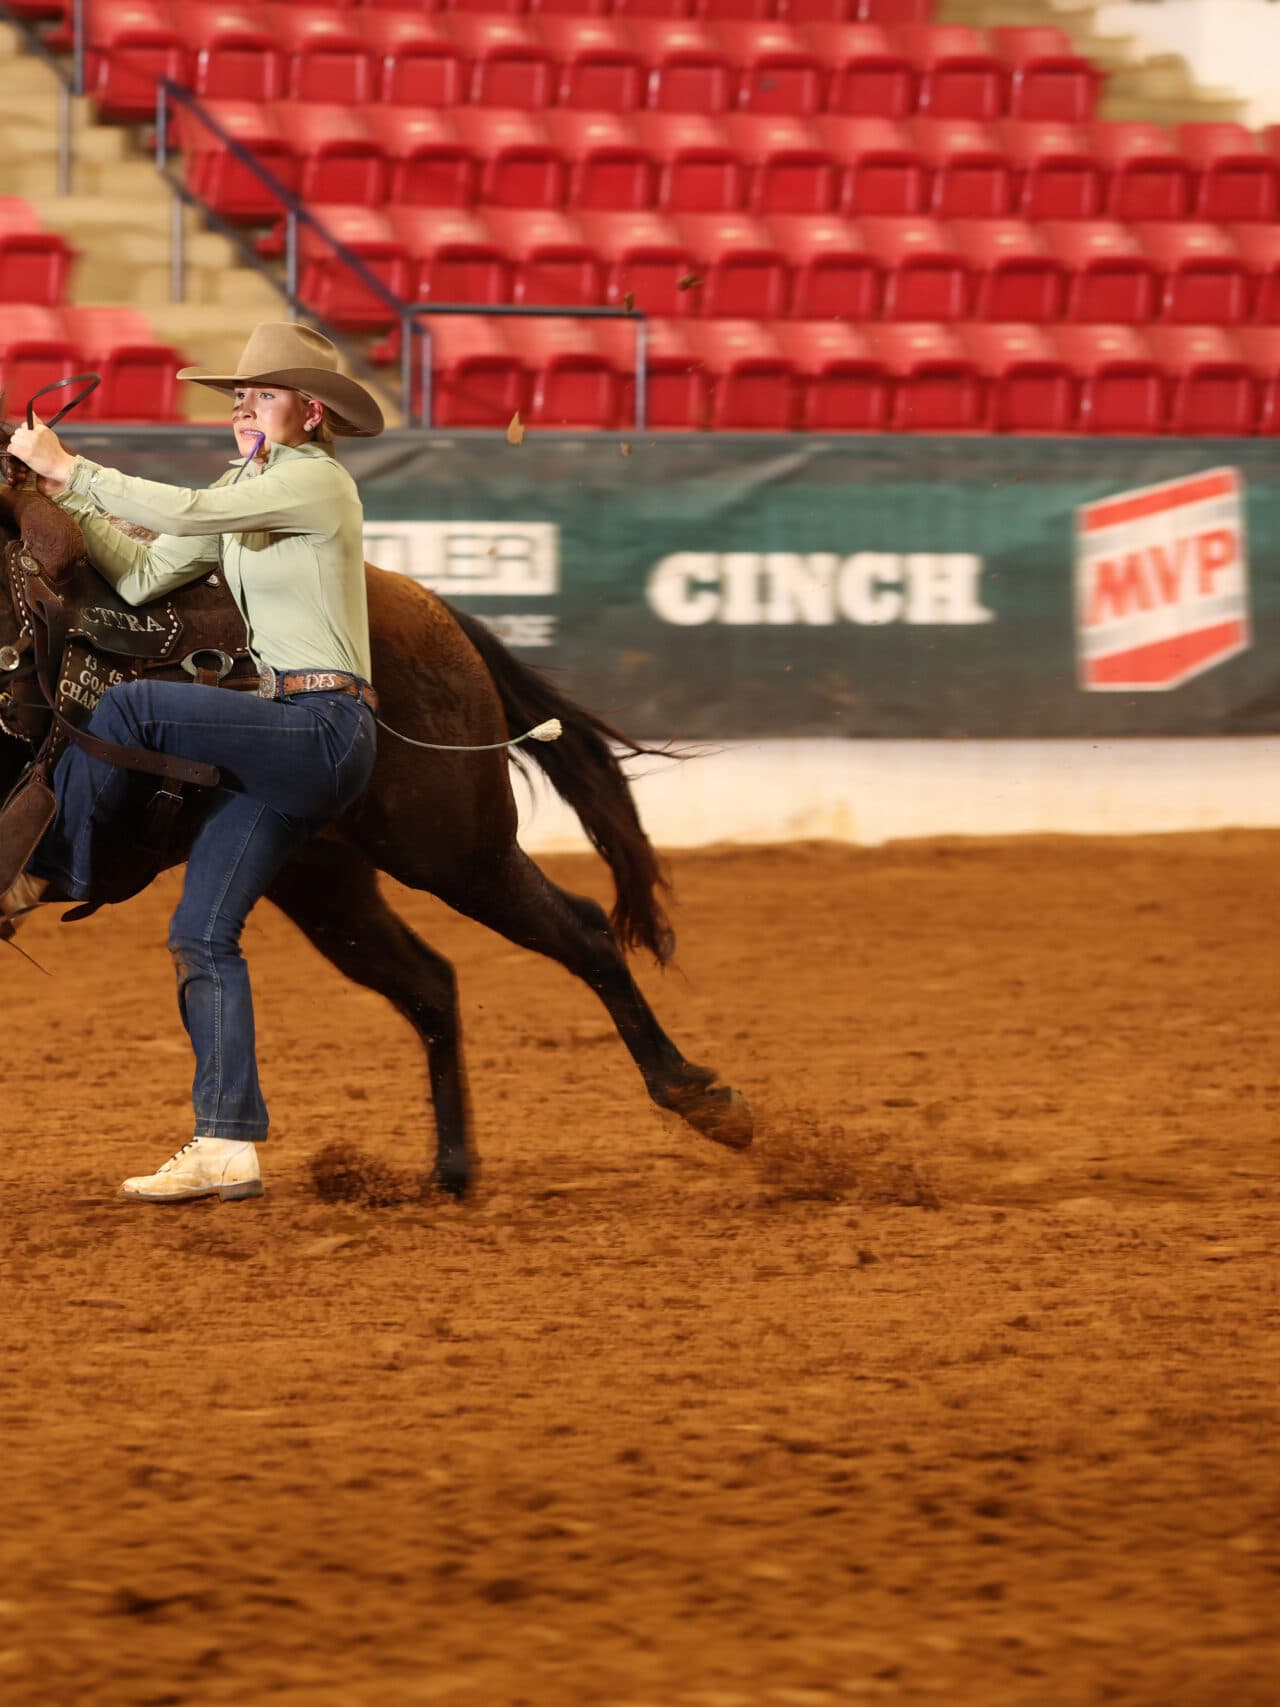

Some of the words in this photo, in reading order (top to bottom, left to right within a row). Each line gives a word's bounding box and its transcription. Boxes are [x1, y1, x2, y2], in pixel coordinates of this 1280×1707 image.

[648, 551, 995, 625] CINCH
[1088, 528, 1237, 625] MVP
[79, 670, 109, 695] GOA
